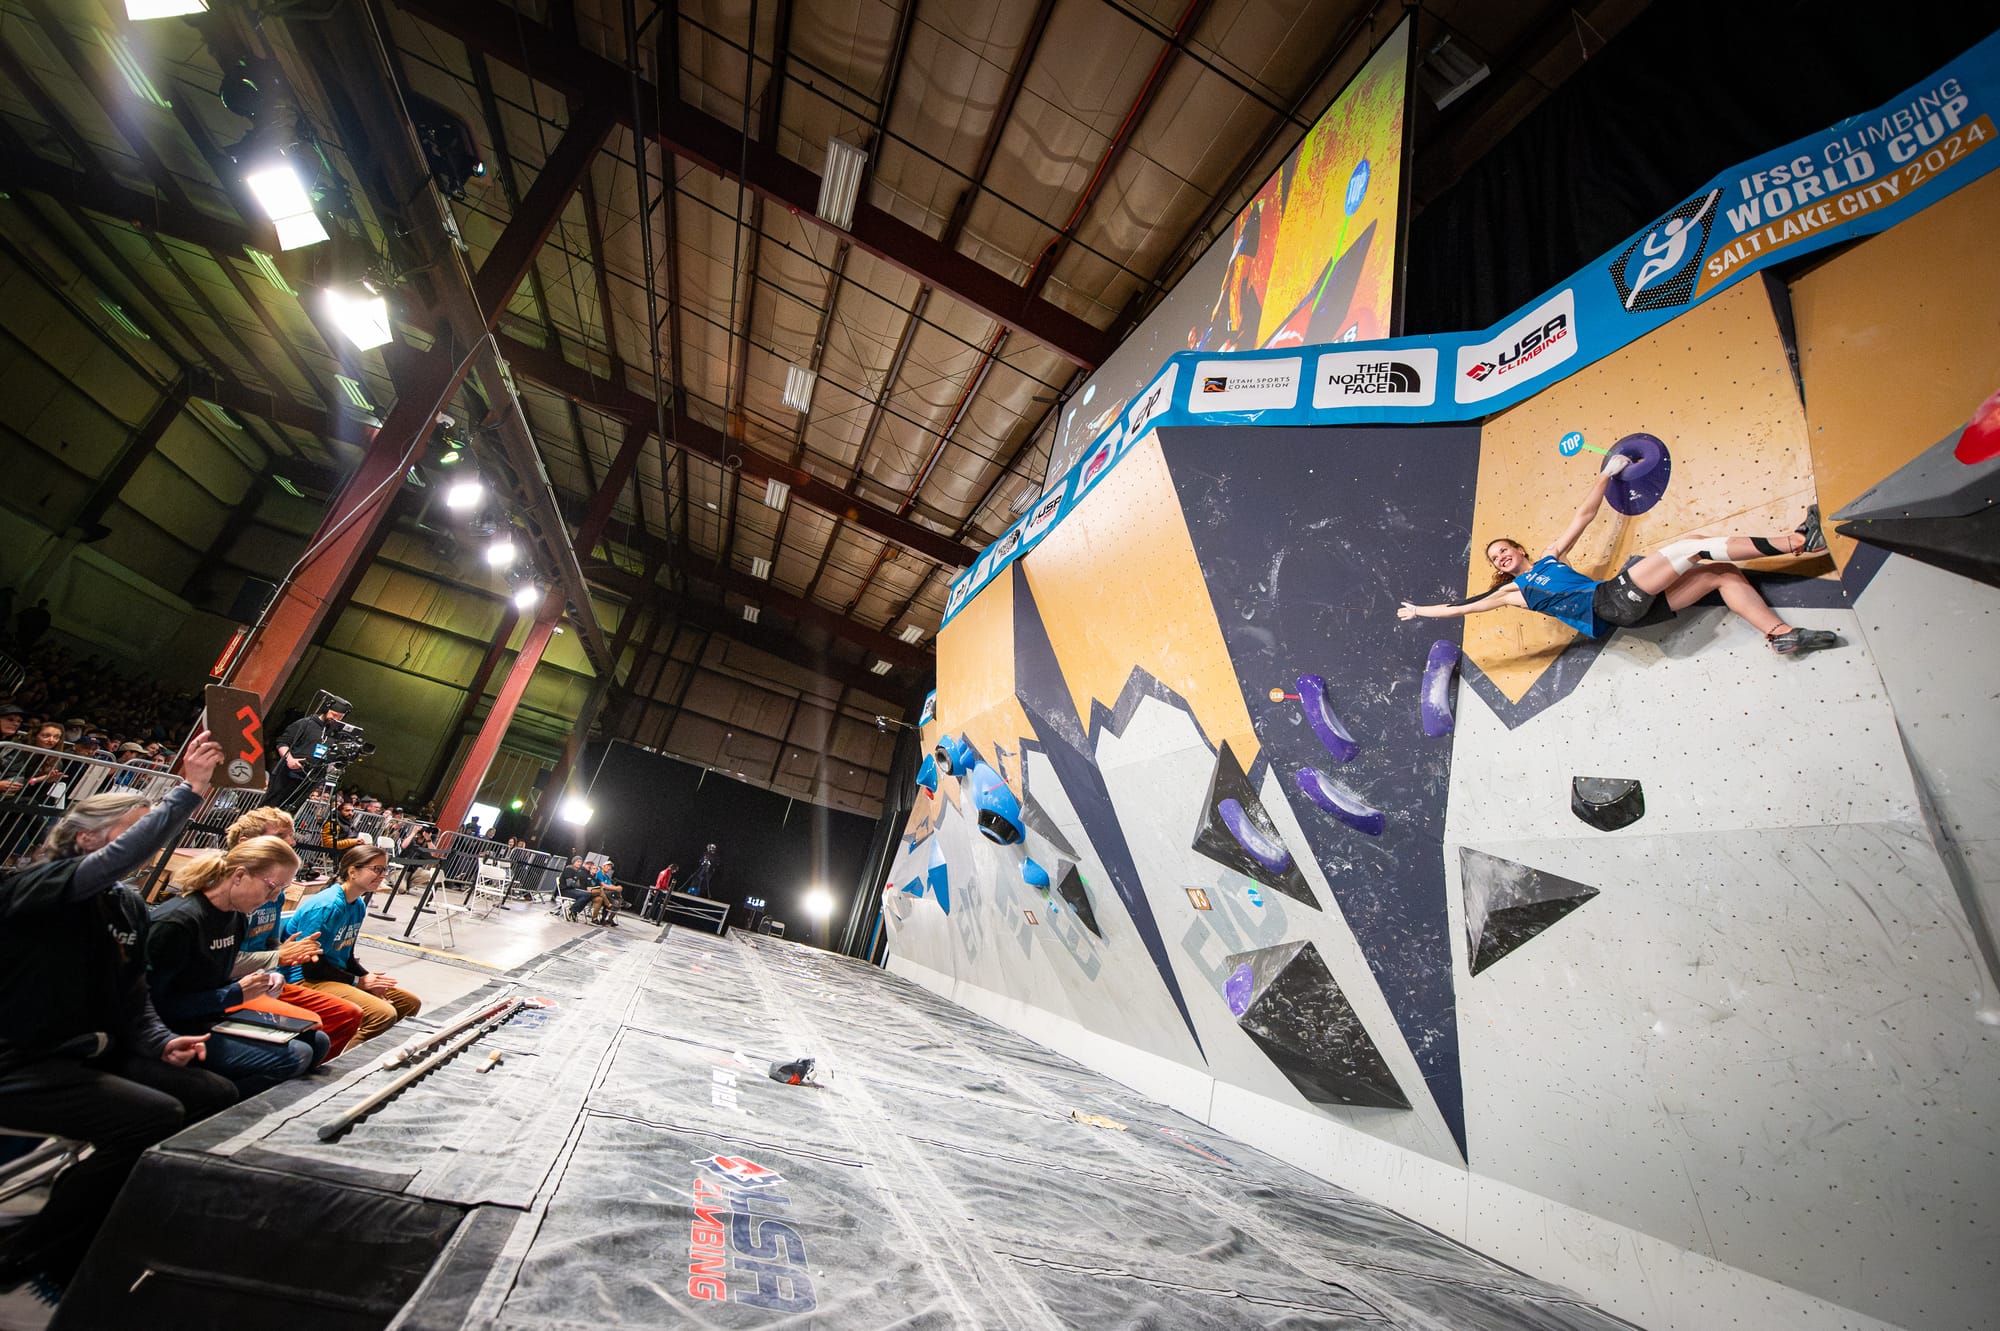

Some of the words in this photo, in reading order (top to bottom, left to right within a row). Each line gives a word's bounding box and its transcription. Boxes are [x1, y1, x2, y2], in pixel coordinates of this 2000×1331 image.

[1740, 156, 1814, 199] IFSC
[1824, 78, 1962, 164] CLIMBING
[1726, 151, 1876, 234] WORLD
[1888, 95, 1969, 163] CUP
[1707, 233, 1762, 278] SALT
[1766, 203, 1836, 244] LAKE
[1838, 175, 1900, 215] CITY
[1906, 124, 1986, 186] 2024
[1498, 328, 1568, 375] CLIMBING
[1499, 314, 1566, 366] USA
[1257, 376, 1290, 384] SPORTS
[1329, 373, 1388, 385] NORTH
[1345, 383, 1387, 394] FACE
[1357, 362, 1389, 373] THE
[1561, 434, 1580, 453] TOP
[236, 705, 264, 764] 3
[729, 1189, 817, 1314] USA
